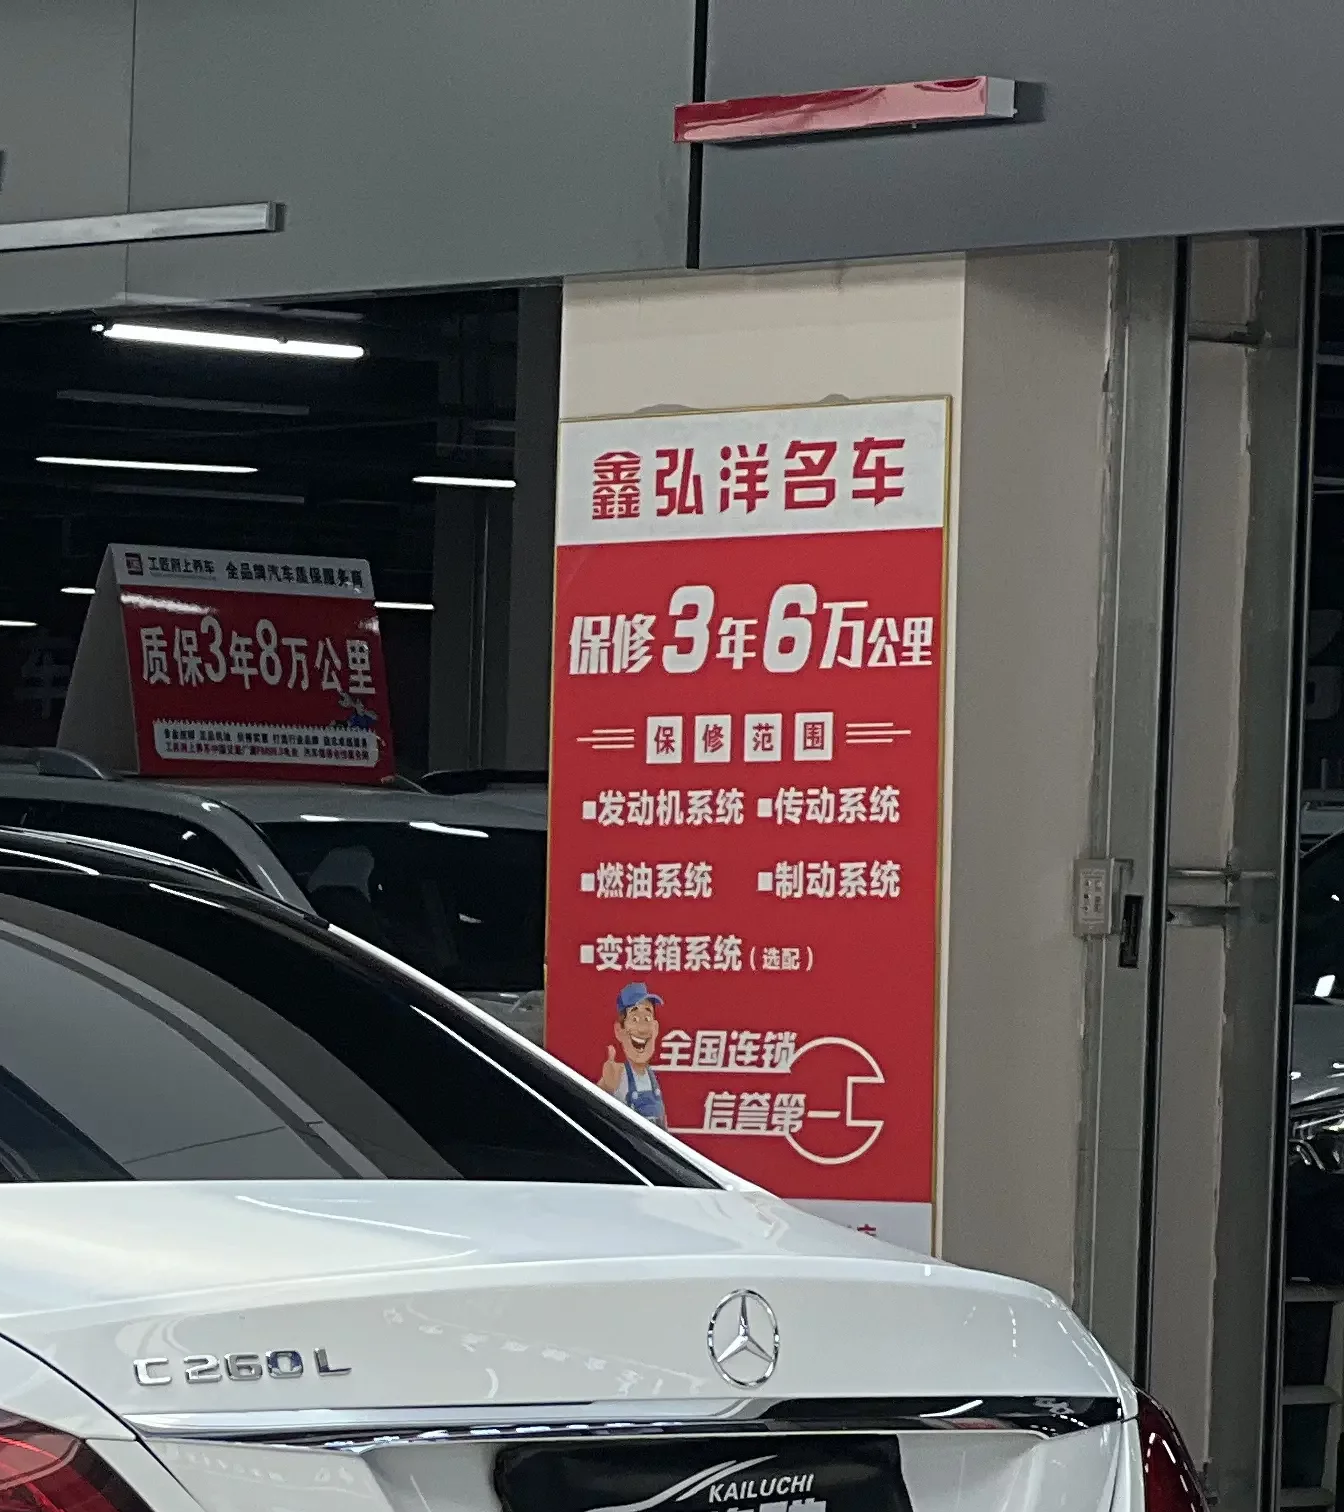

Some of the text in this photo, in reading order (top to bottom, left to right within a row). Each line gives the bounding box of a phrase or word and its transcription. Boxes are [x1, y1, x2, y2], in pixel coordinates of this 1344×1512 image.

[591, 436, 907, 521] 鑫弘洋名车
[568, 583, 934, 675] 保修3年6万公里
[139, 615, 377, 694] 质保3年8万公里
[650, 718, 829, 758] 保修范围
[597, 788, 745, 826] 发动机系统
[774, 785, 901, 825] 传动系统
[596, 861, 713, 899] 燃油系统
[774, 860, 902, 899] 制动系统
[595, 933, 743, 973] 变速箱系统
[658, 1029, 798, 1070] 全国连锁
[703, 1090, 842, 1134] 信誉第一
[708, 1473, 815, 1504] KAILUCHI
